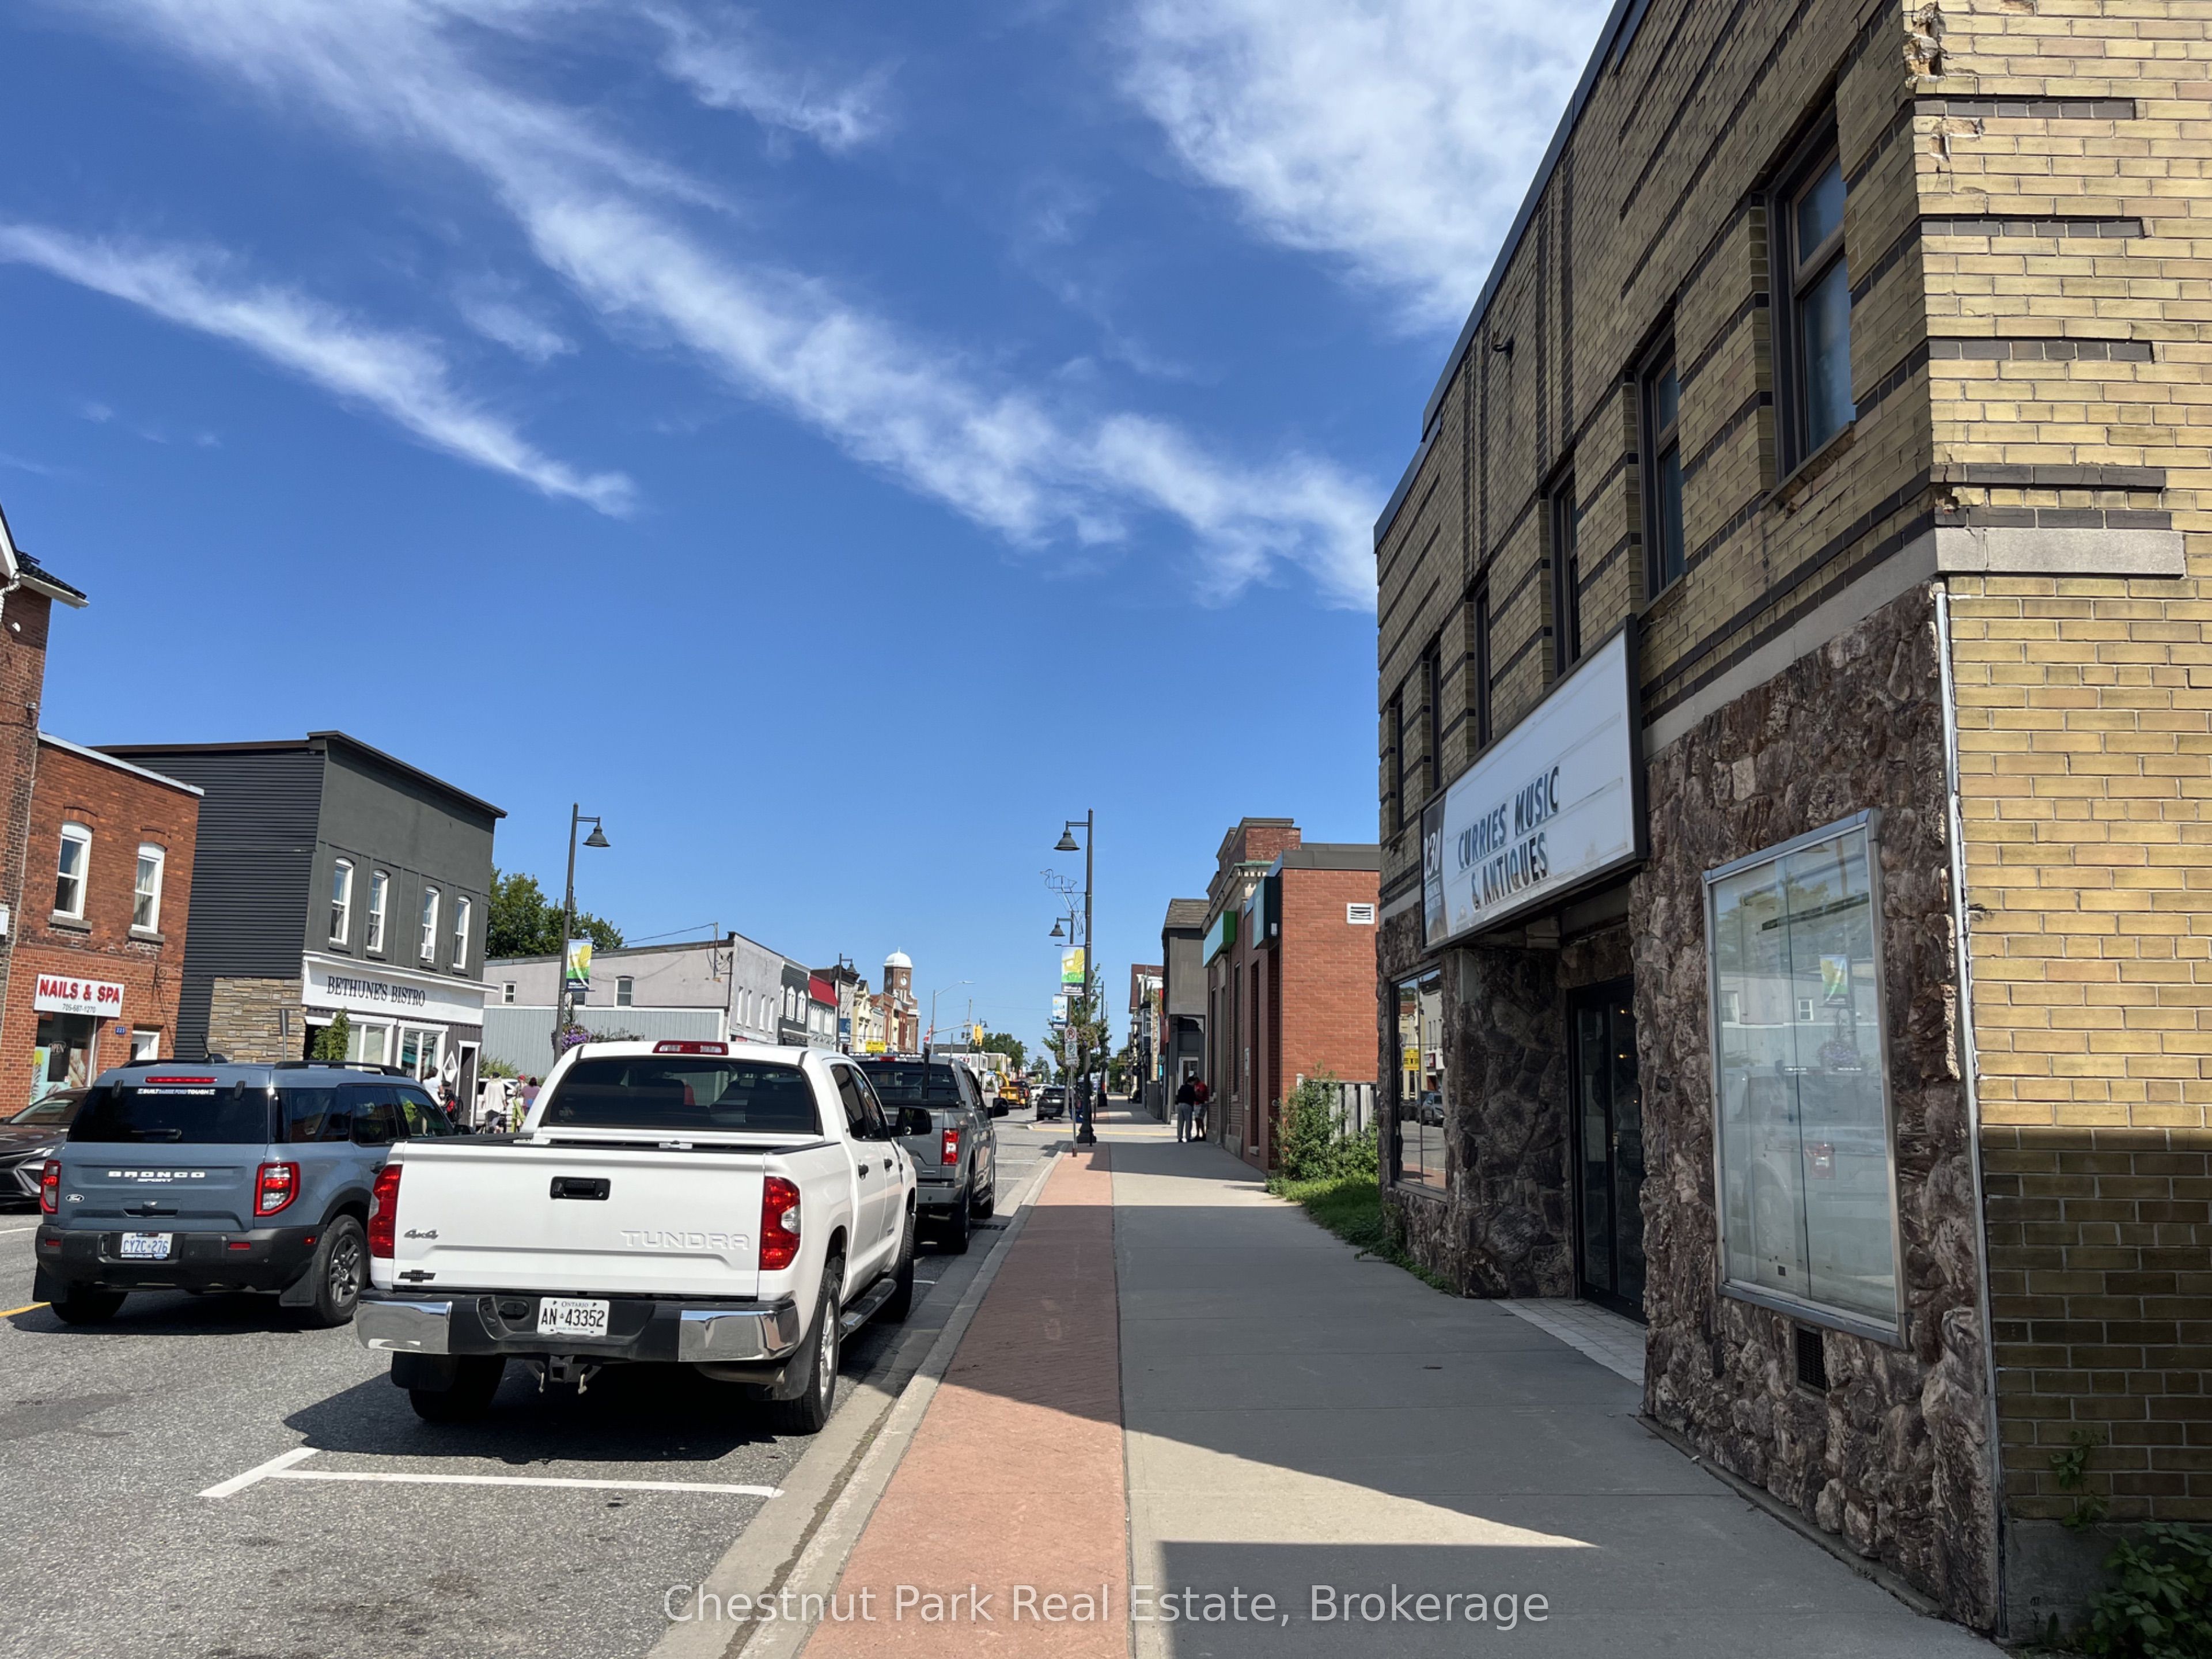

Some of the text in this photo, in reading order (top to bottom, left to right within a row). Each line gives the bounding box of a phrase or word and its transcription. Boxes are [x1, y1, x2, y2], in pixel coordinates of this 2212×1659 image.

[1458, 766, 1559, 870] CURRIES MUSIC
[1471, 872, 1481, 911] &
[1483, 832, 1548, 906] ANTIQUES
[39, 979, 120, 1004] NAILS & SPA
[327, 976, 426, 1007] BETHUNE'S BISTRO
[48, 1043, 65, 1054] OPEN
[151, 1240, 168, 1254] 276
[620, 1230, 749, 1250] TUNDRA
[541, 1308, 605, 1327] AN 43352
